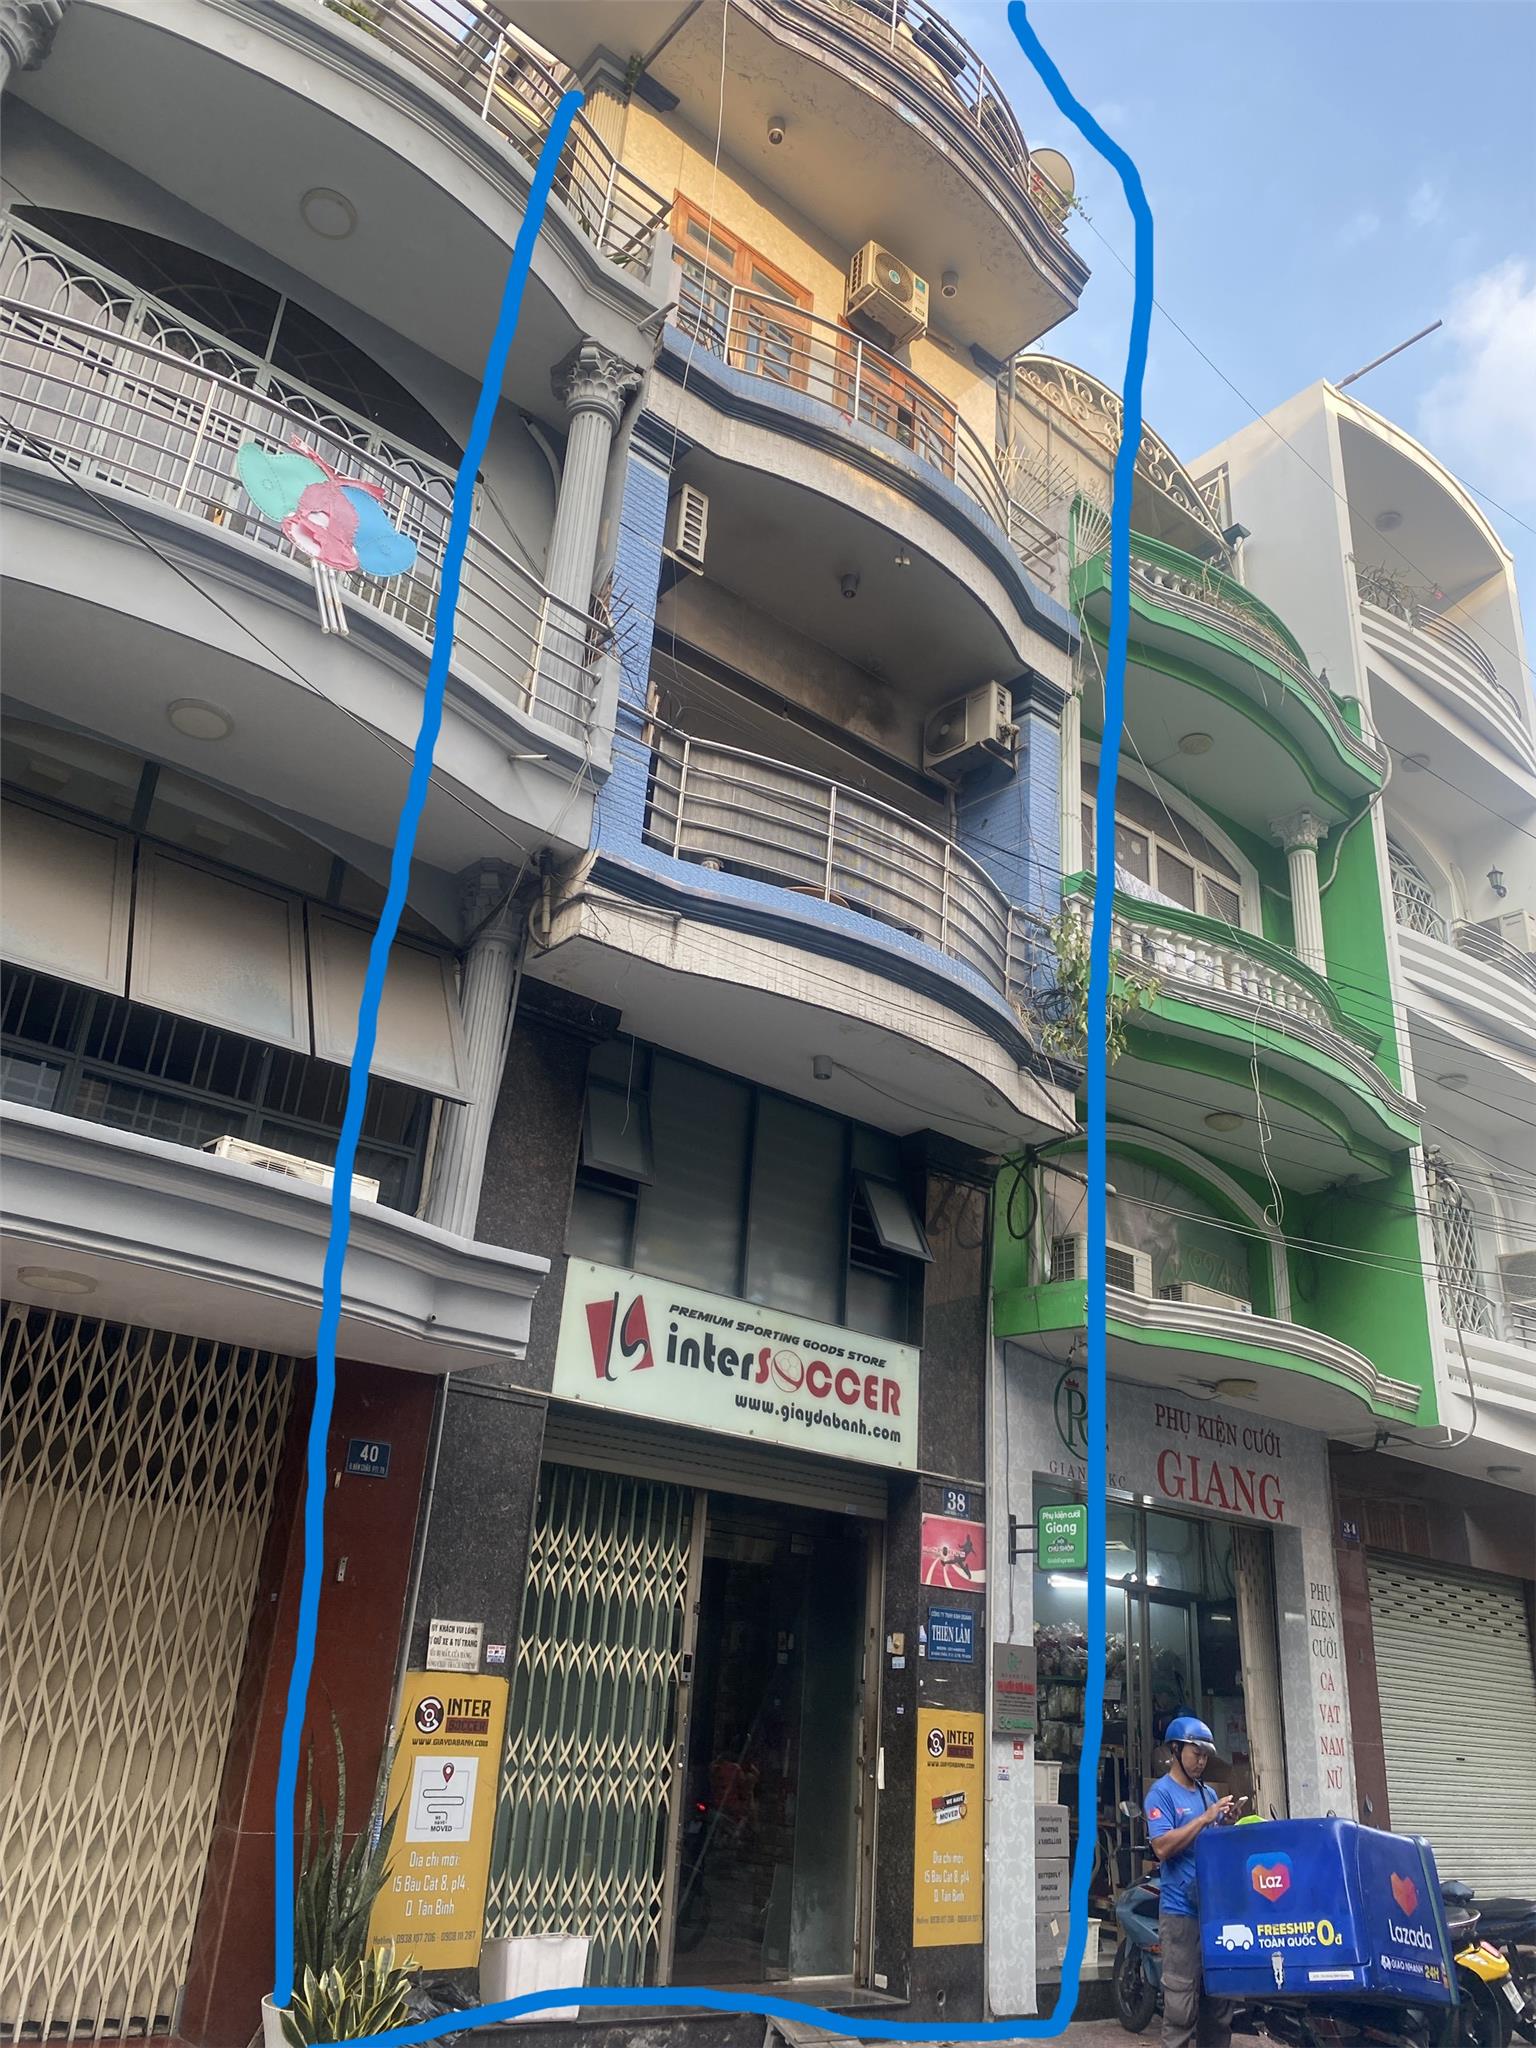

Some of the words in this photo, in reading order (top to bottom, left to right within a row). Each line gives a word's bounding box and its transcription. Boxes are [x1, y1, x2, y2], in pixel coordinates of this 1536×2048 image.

[669, 1304, 734, 1328] PREMIUM
[736, 1321, 800, 1346] SPORTING
[803, 1339, 845, 1357] GOODS
[847, 1350, 887, 1368] STORE
[735, 1394, 901, 1443] www.giaydabanh.com
[1155, 1403, 1191, 1440] PHỤ
[1196, 1414, 1237, 1448] KIỆN
[1243, 1427, 1282, 1458] CƯỚI
[360, 1444, 379, 1462] 40
[1157, 1449, 1285, 1521] GIANG
[947, 1491, 965, 1512] 38
[1045, 1521, 1077, 1536] Giang
[1310, 1582, 1331, 1606] PHỤ
[439, 1622, 455, 1633] KHÁCH
[456, 1626, 464, 1634] VUI
[1310, 1606, 1335, 1631] KIỆN
[442, 1637, 449, 1646] XE
[461, 1639, 478, 1648] TRANG
[1312, 1636, 1338, 1660] CƯỚI
[1320, 1668, 1335, 1692] CÀ
[447, 1698, 491, 1717] INTER
[946, 1729, 974, 1746] INTER
[1320, 1736, 1345, 1757] NAM
[939, 1809, 958, 1820] MOVED
[392, 1875, 402, 1893] 15
[1259, 1874, 1283, 1889] Laz
[1256, 1921, 1316, 1937] FREESHIP
[1388, 1918, 1433, 1950] Lazada
[1258, 1935, 1285, 1949] TOÀN
[1287, 1933, 1317, 1948] QUỐC
[1424, 1964, 1440, 1980] 24H
